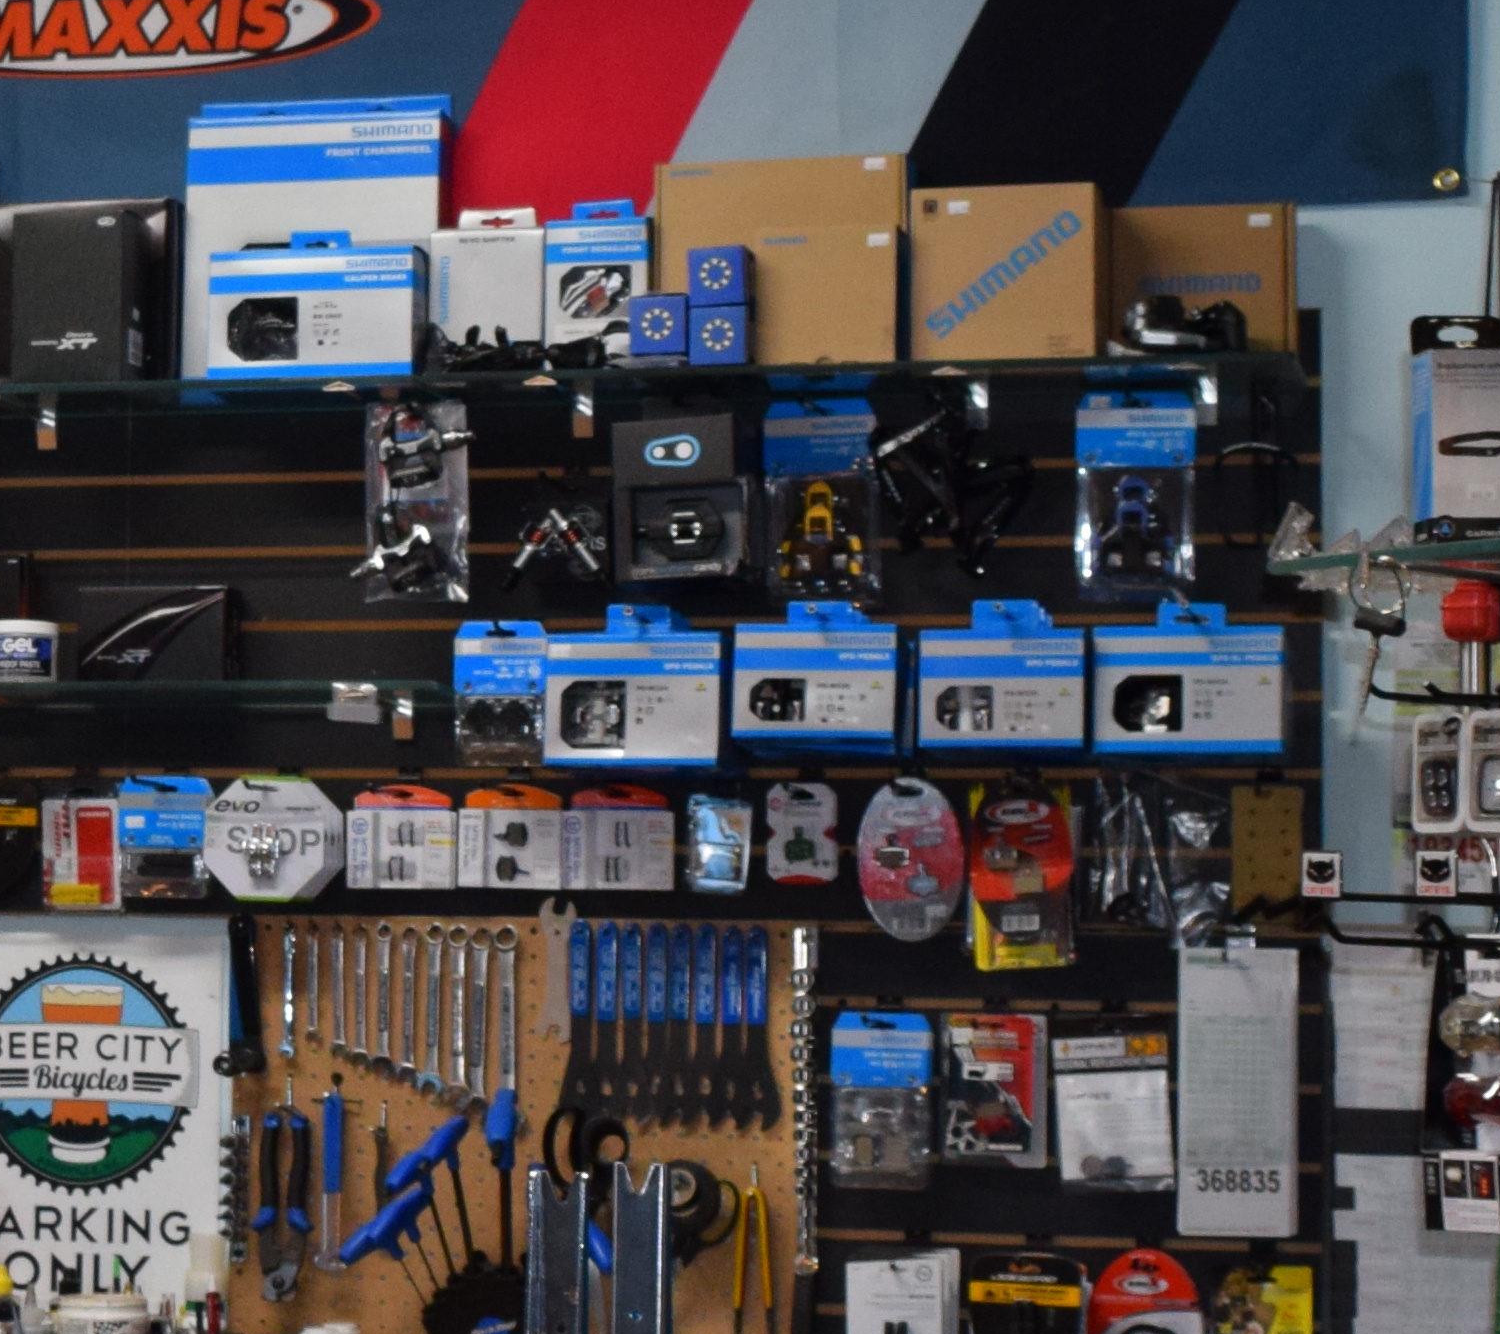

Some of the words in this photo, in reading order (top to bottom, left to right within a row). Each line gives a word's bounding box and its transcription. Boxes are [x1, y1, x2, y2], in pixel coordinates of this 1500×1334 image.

[351, 123, 433, 139] SHIMANO
[324, 146, 364, 158] FRONT
[367, 143, 433, 156] CHAINWHEEL
[578, 228, 642, 241] SHIMANO
[345, 257, 408, 269] SHIMANO
[923, 209, 1083, 342] SHIMANO
[1140, 272, 1262, 294] SHIMANO
[824, 632, 891, 647] SHIMANO
[1012, 639, 1079, 653] SHIMANO
[1209, 637, 1281, 652] SHIMANO
[651, 644, 716, 657] SHIMANO
[214, 798, 261, 814] evo
[96, 1034, 183, 1065] CITY
[33, 1064, 130, 1098] Bicycles
[1196, 1167, 1282, 1193] 368835
[4, 1251, 151, 1295] ONLY
